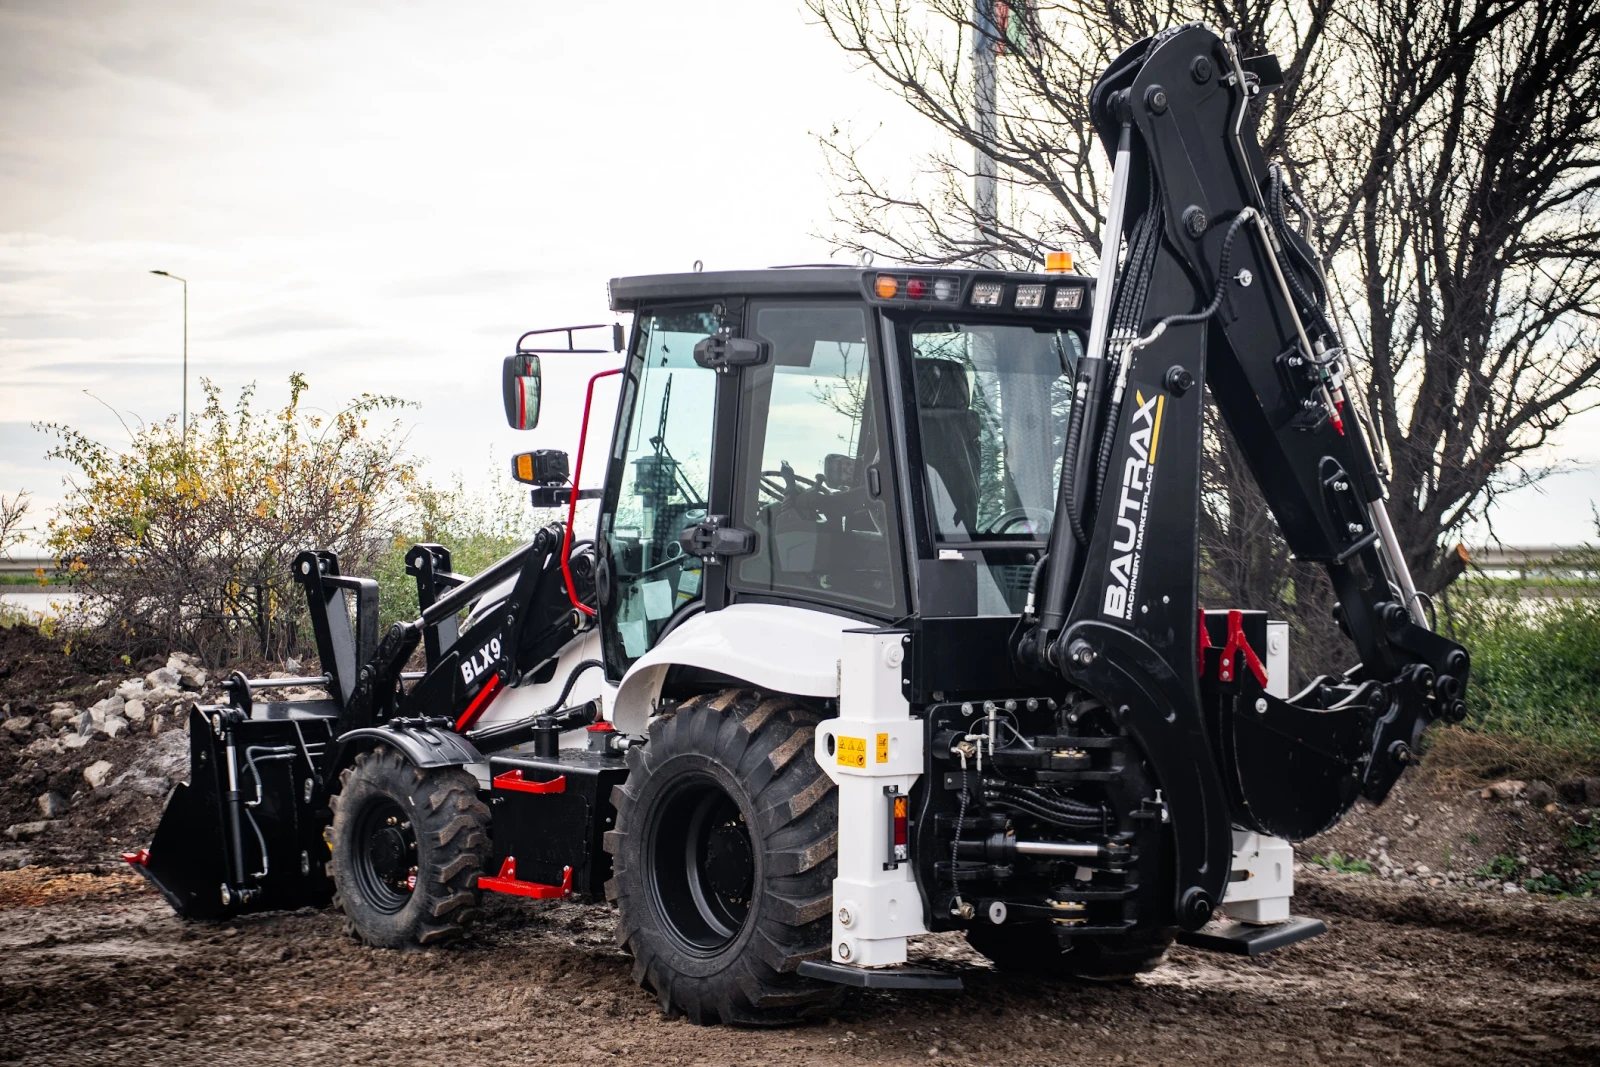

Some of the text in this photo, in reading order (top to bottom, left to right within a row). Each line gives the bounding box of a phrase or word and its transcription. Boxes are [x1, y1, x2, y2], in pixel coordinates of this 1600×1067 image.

[1103, 389, 1157, 619] BAUTRAX
[1125, 465, 1154, 620] MACHINERY MARKETPLACE
[460, 633, 502, 685] BLX9
